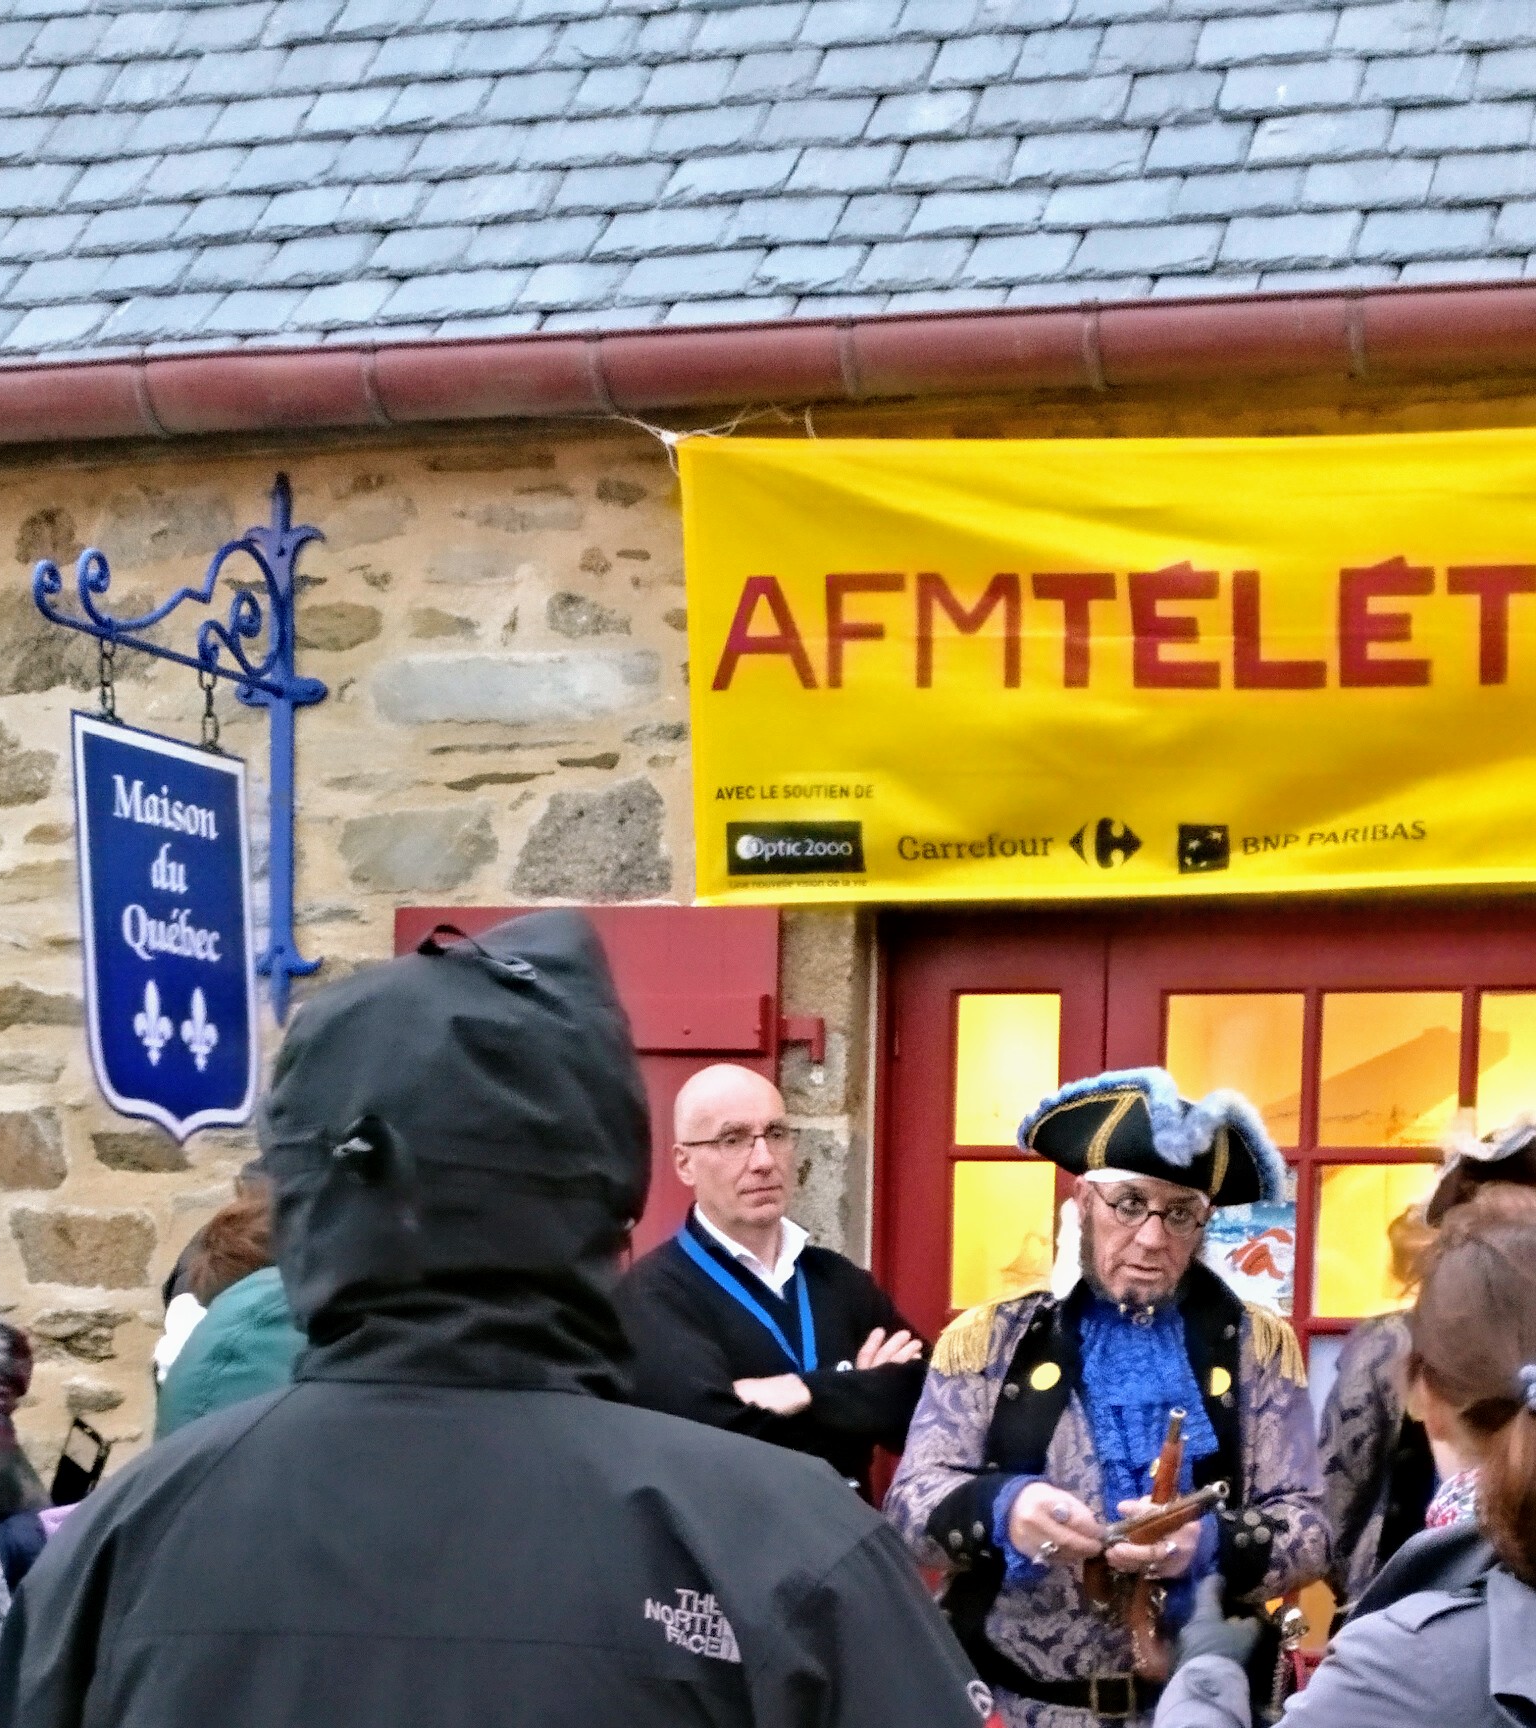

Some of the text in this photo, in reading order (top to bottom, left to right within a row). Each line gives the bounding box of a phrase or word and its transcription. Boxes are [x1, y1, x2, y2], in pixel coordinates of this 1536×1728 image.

[112, 773, 219, 841] Maison
[716, 783, 875, 801] AVEC LE SOUTIEN DE
[897, 831, 1055, 862] Carrefour
[1242, 820, 1427, 856] BNP PARIBAS
[150, 842, 188, 894] du
[121, 903, 222, 963] Québec
[644, 1597, 725, 1637] NORTH
[675, 1588, 723, 1616] THE
[665, 1624, 722, 1659] FACE
